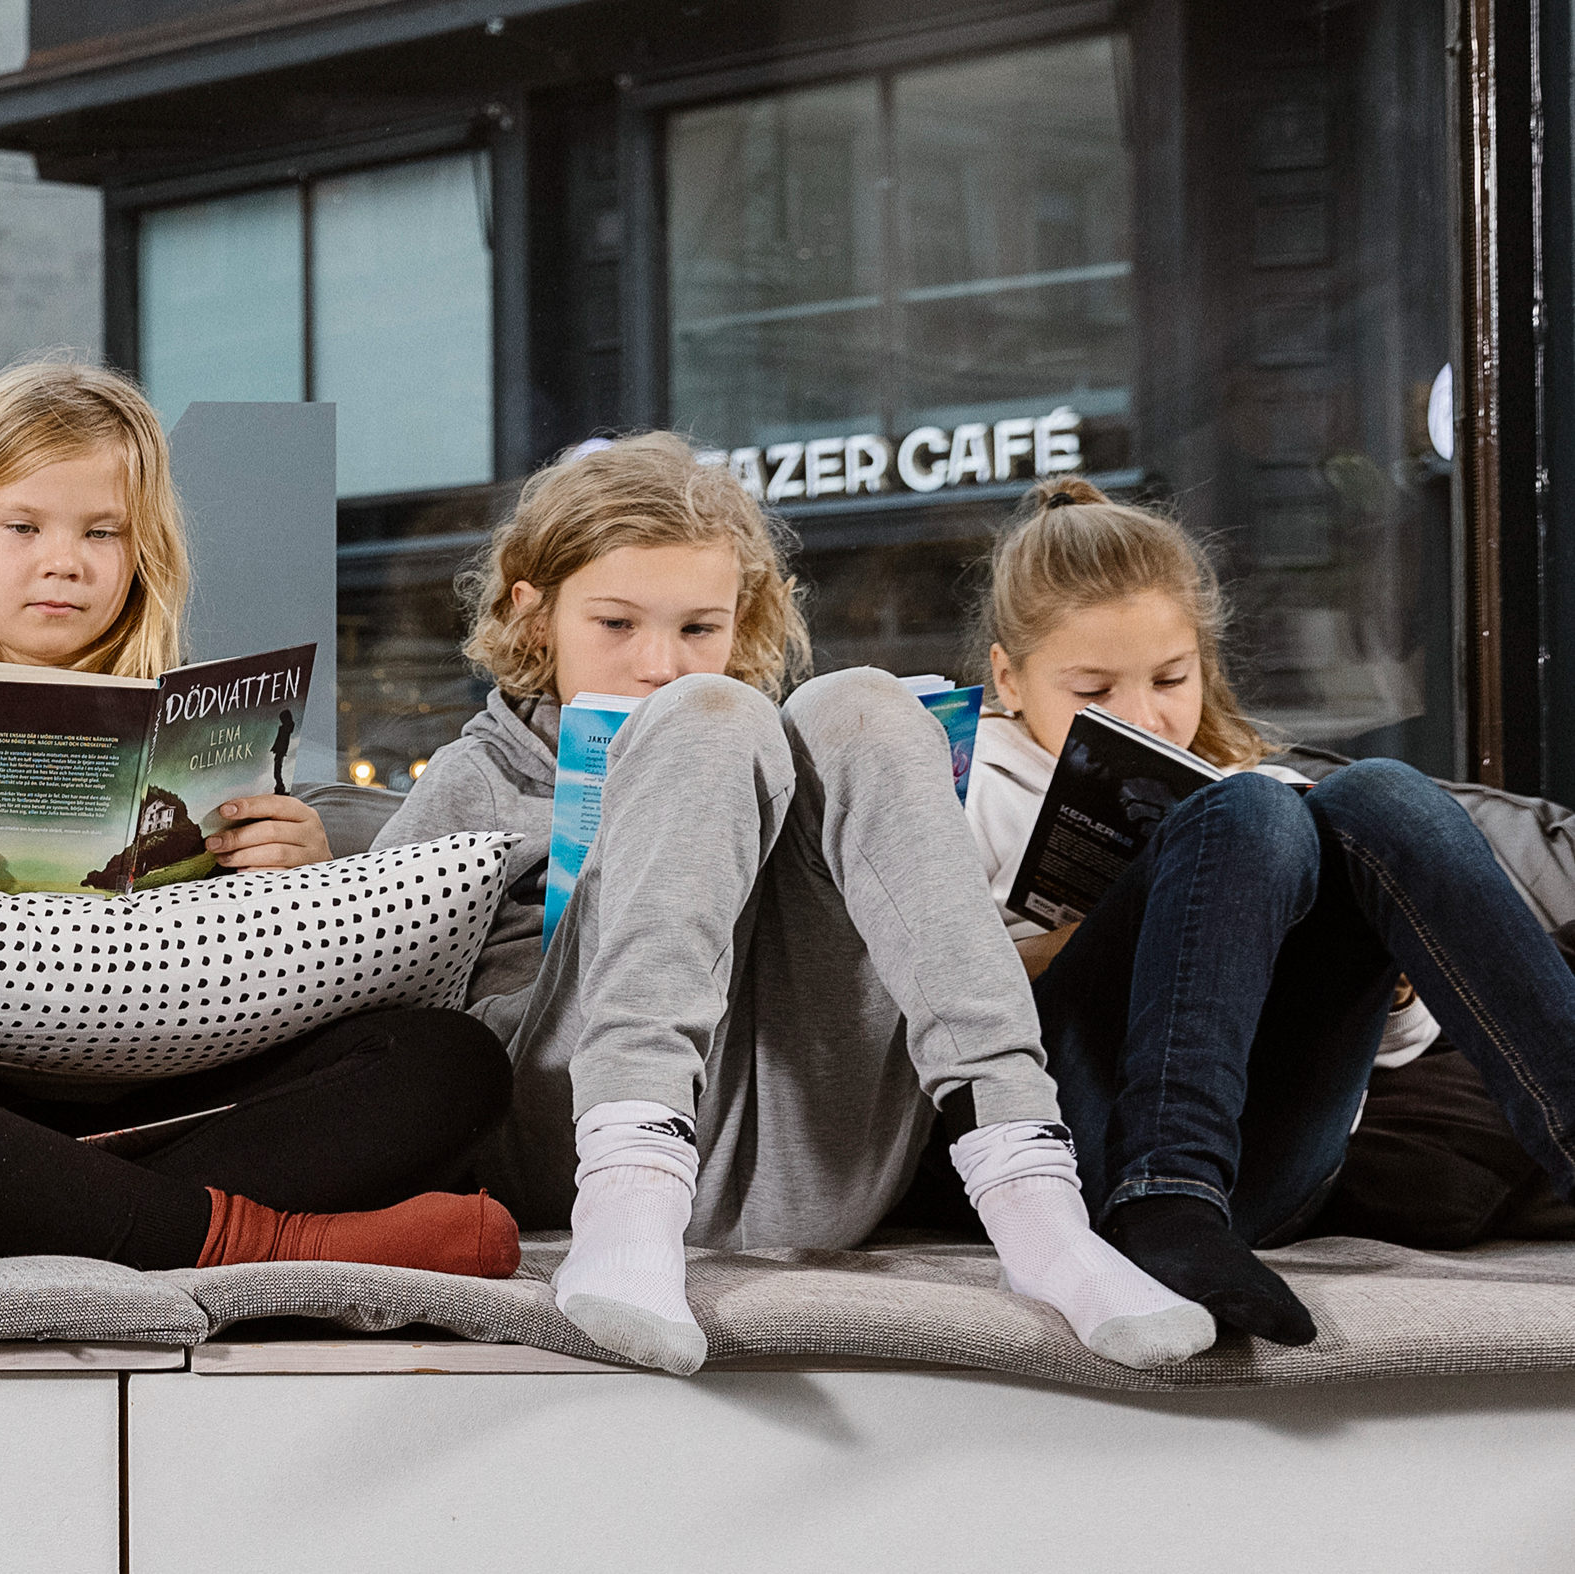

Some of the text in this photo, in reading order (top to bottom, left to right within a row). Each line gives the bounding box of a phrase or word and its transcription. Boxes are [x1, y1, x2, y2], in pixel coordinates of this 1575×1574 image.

[897, 406, 1082, 492] CAFÉ
[166, 667, 300, 724] DÖDVATTEN
[190, 742, 254, 770] OLLMARK
[210, 724, 242, 746] LENA
